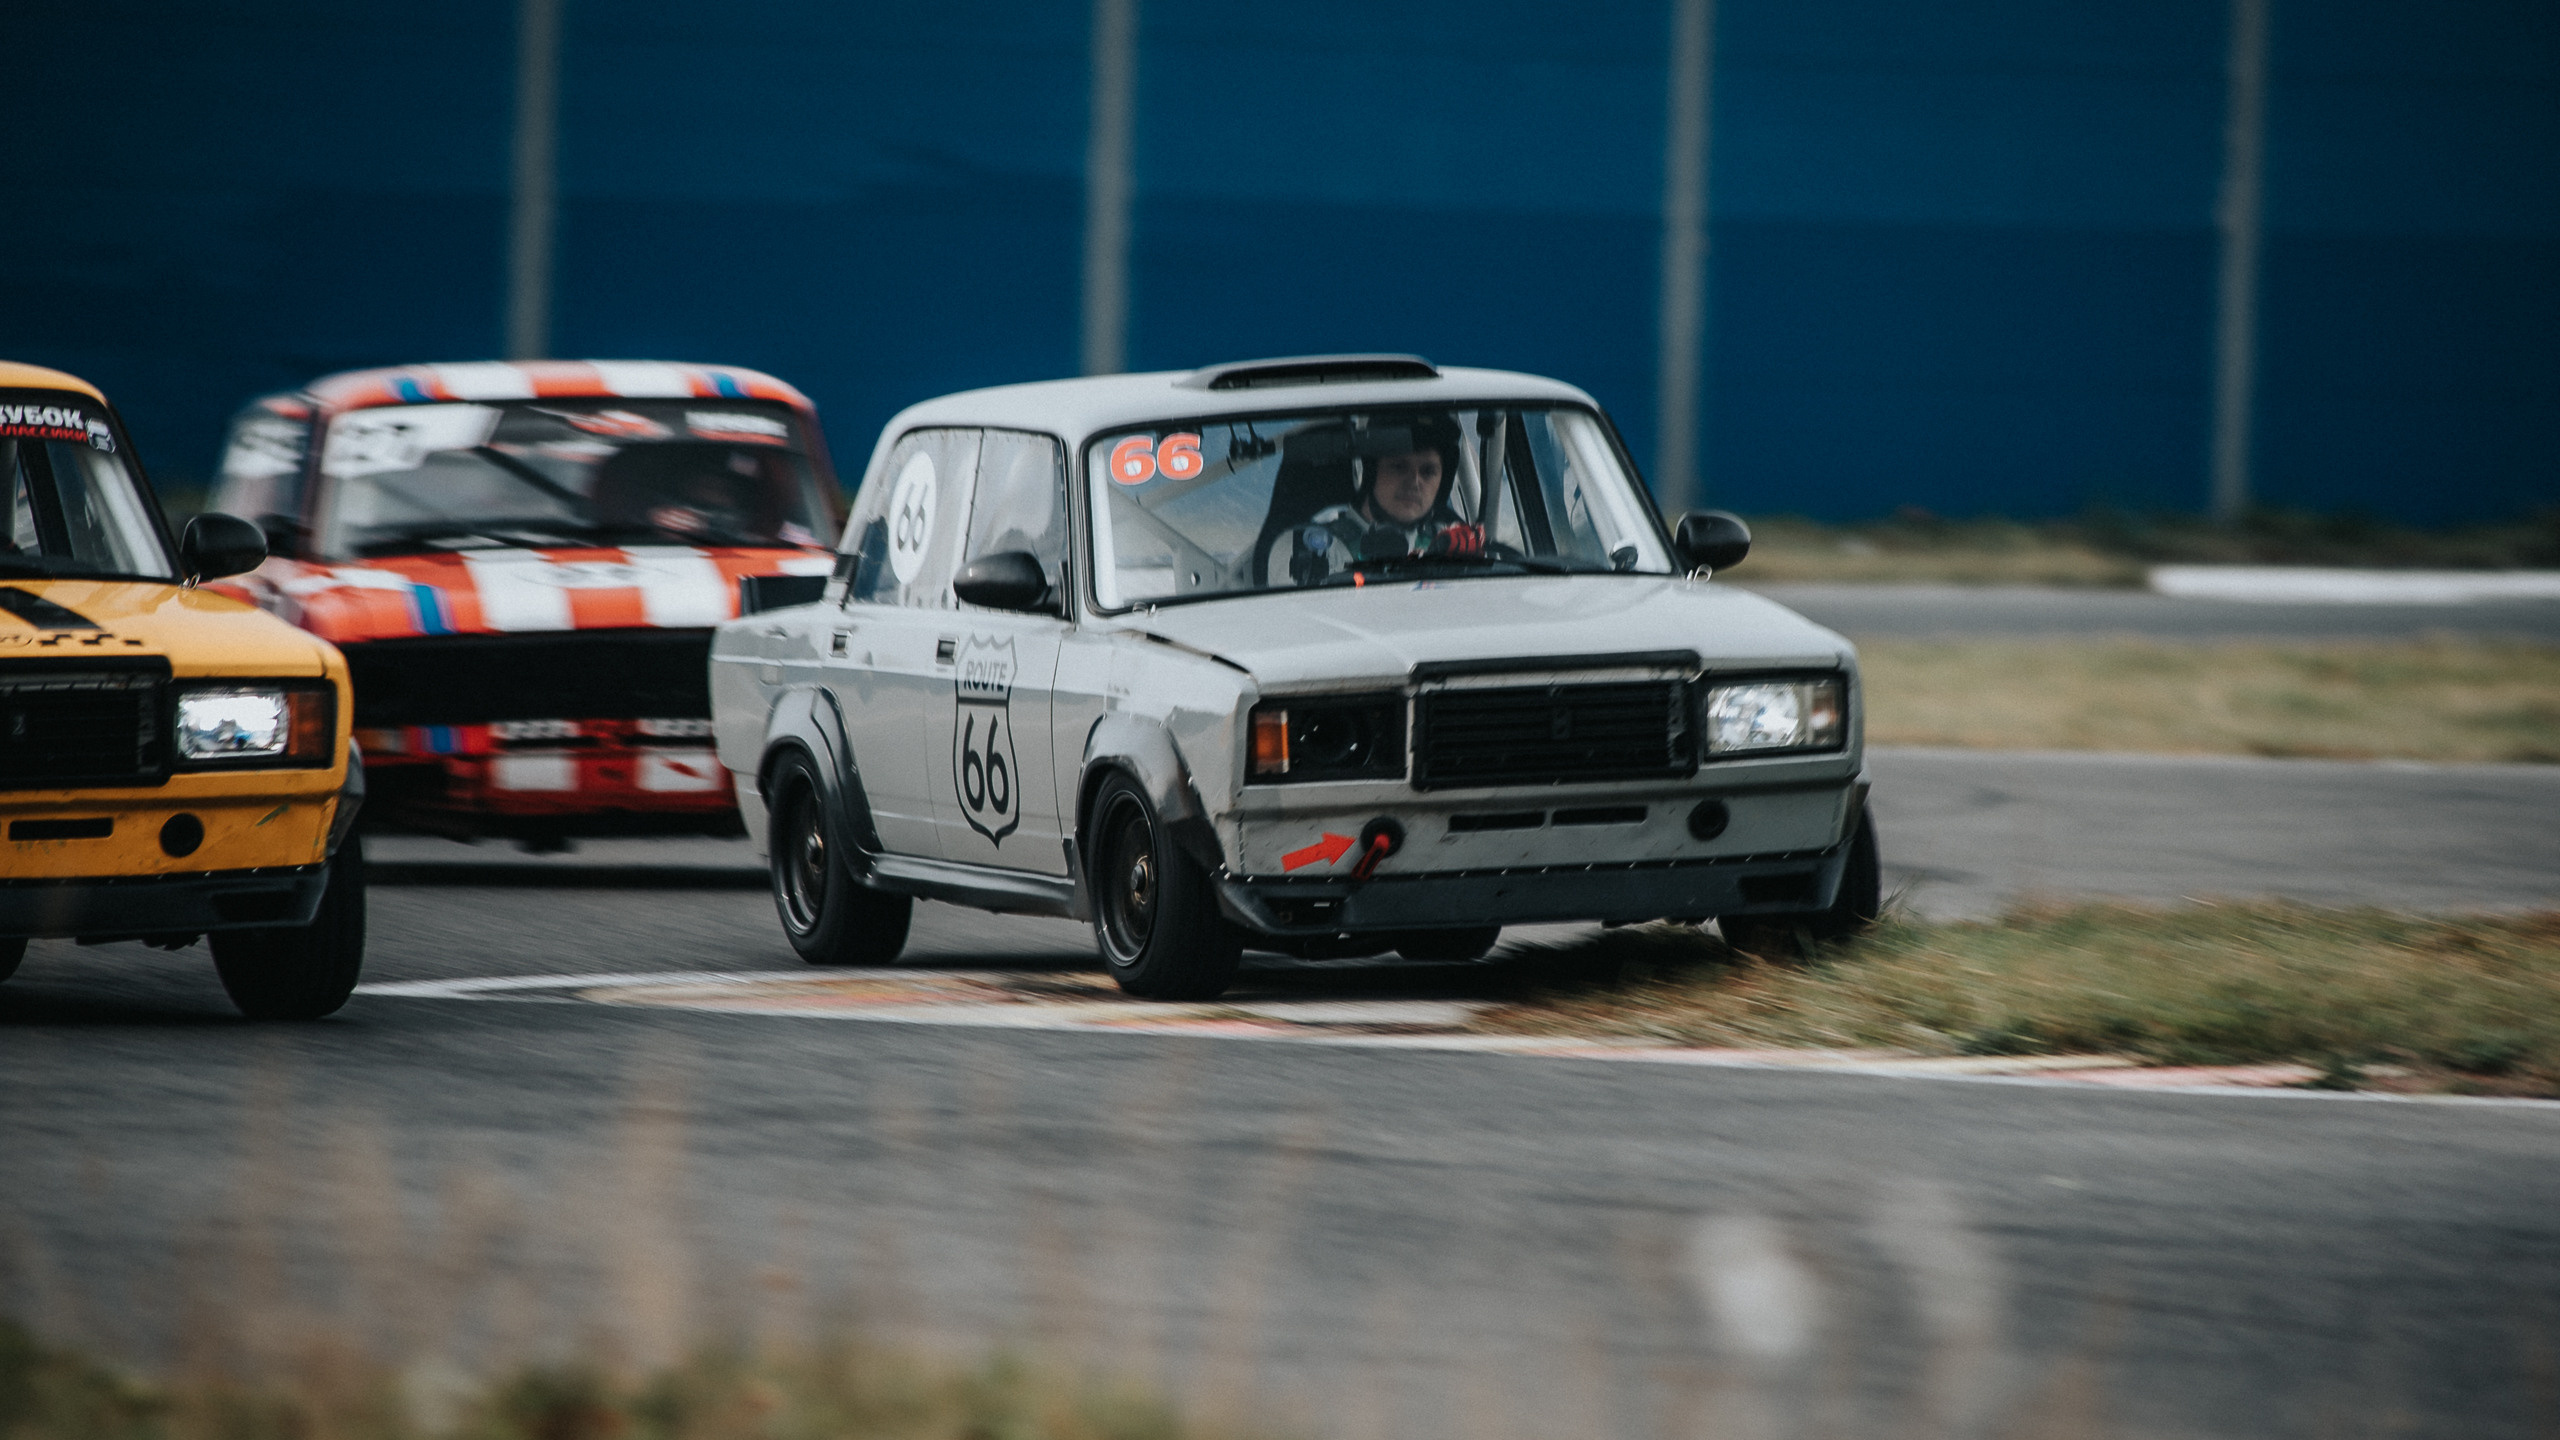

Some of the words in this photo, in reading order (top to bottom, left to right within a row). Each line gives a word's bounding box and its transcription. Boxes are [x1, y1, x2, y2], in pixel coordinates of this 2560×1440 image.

[1110, 432, 1204, 486] 66
[897, 482, 928, 553] 66
[963, 659, 1008, 693] ROUTE
[962, 711, 1010, 816] 66
